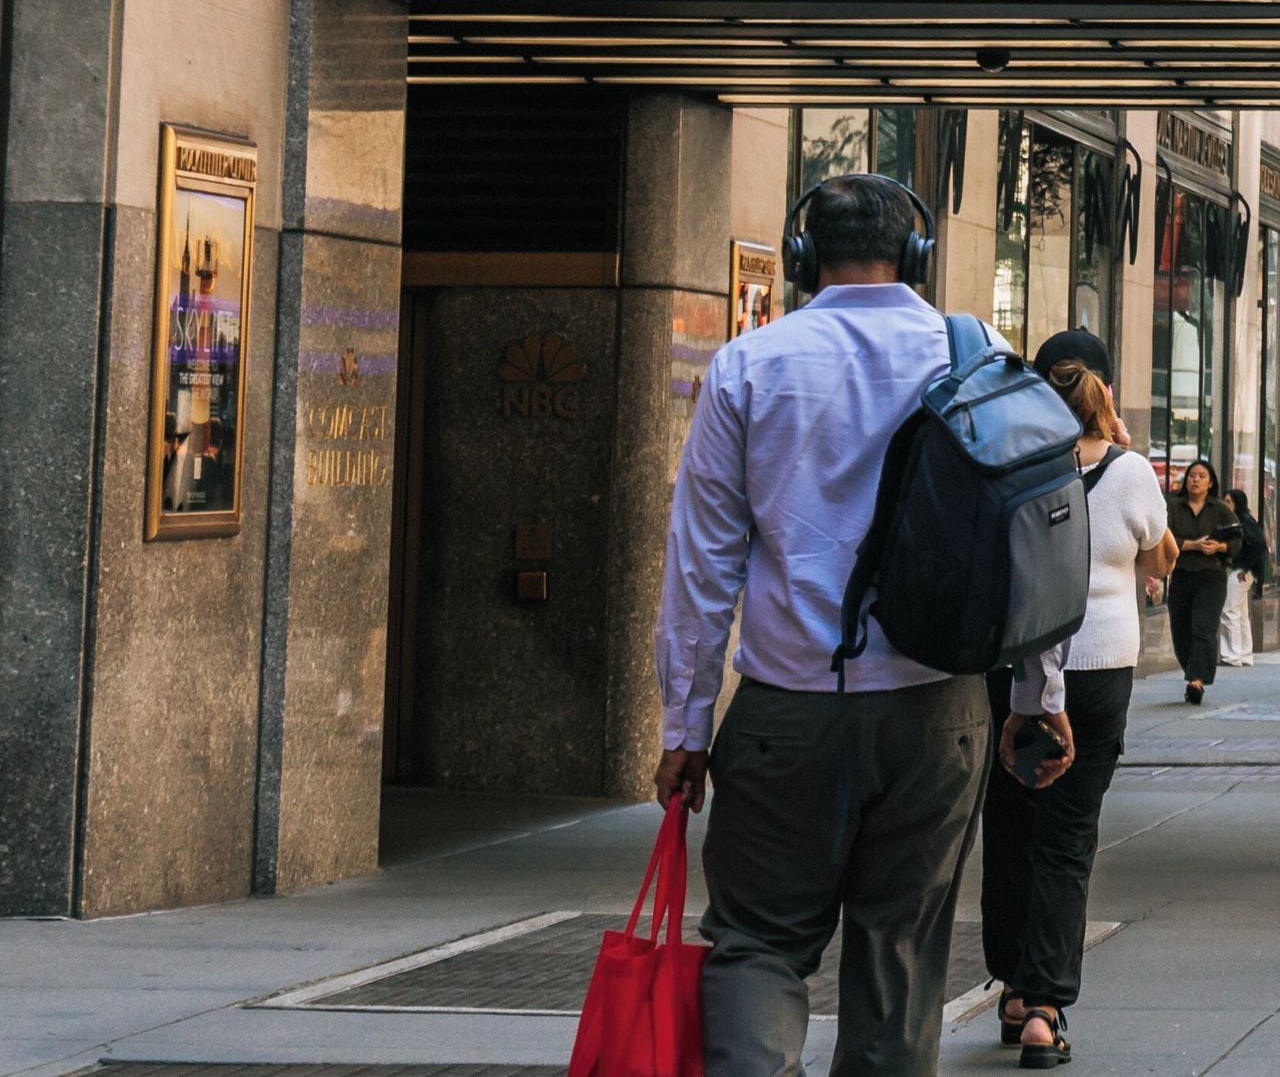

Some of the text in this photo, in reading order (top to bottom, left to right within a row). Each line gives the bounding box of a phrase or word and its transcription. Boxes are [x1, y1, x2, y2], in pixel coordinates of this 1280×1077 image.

[308, 403, 388, 440] COMCAST
[503, 388, 576, 419] NBC
[307, 449, 388, 487] BUILDING
